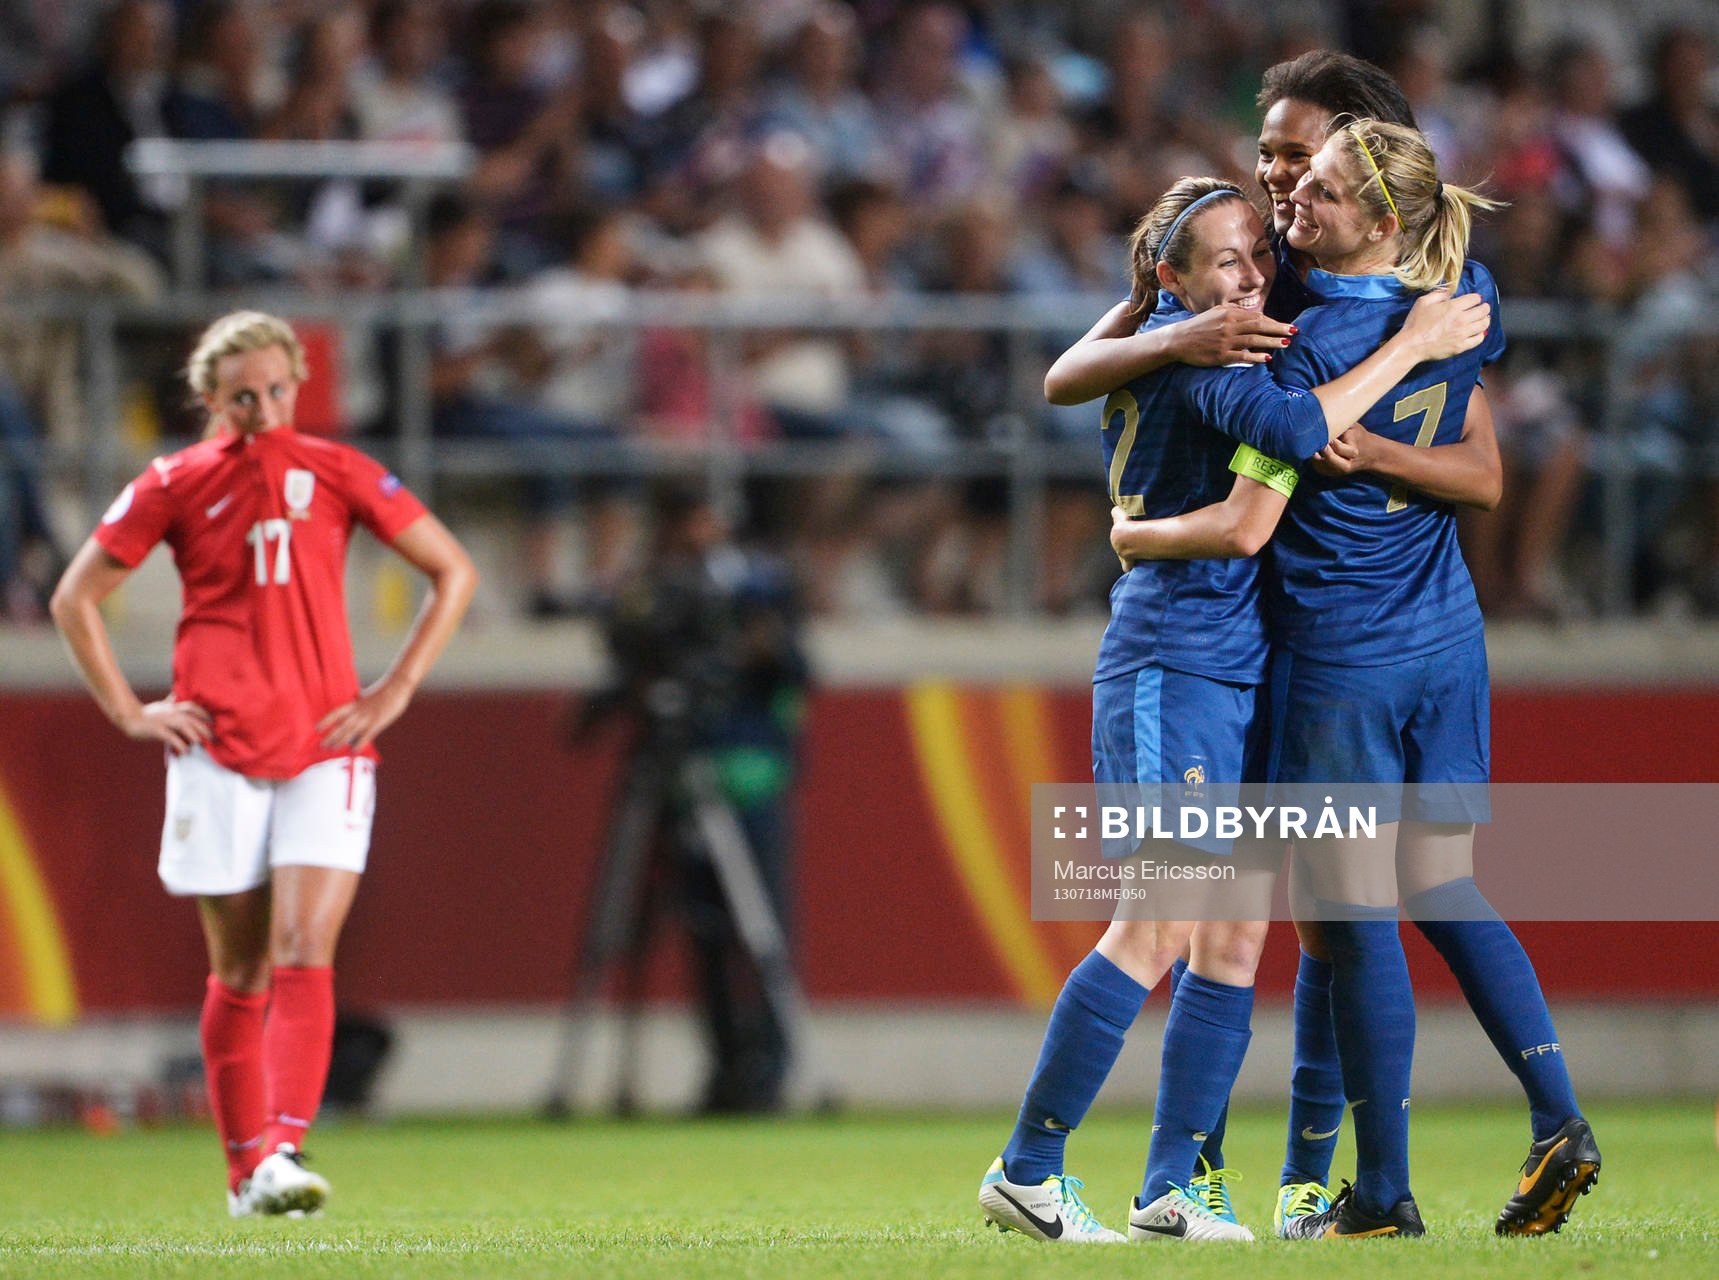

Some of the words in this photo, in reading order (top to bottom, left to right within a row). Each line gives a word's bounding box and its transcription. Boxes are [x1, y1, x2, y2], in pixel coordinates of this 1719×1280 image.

[1386, 381, 1447, 513] 7
[246, 518, 291, 586] 17
[1521, 1043, 1560, 1060] FFF
